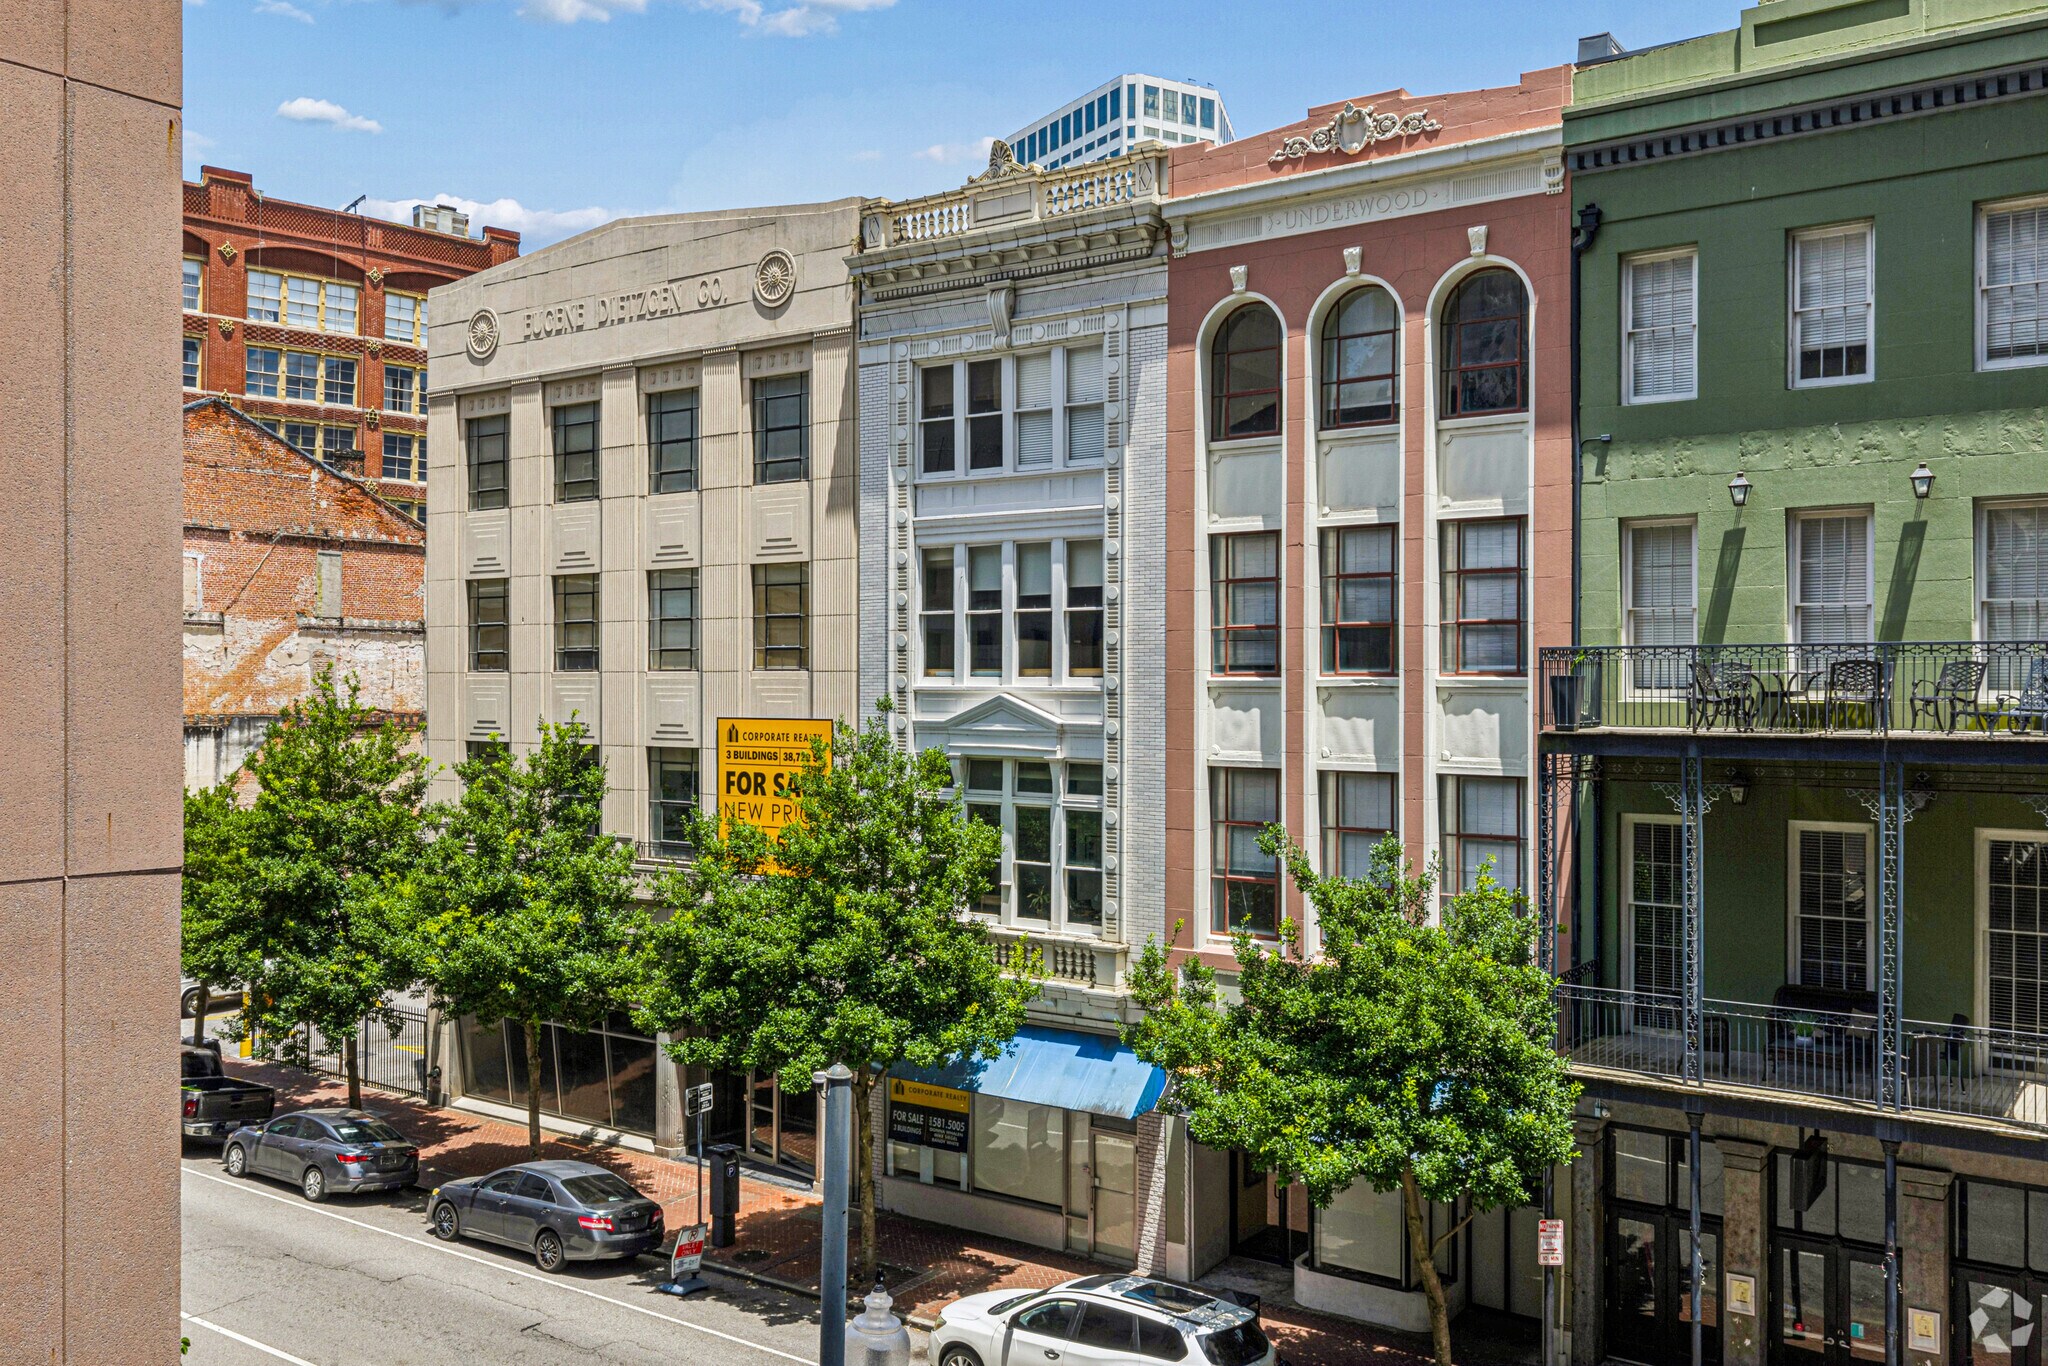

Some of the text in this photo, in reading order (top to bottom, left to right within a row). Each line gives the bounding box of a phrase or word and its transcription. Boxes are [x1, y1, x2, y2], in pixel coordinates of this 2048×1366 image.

[1284, 187, 1428, 229] UNDERWOOD
[523, 303, 585, 340] EUGENE
[598, 284, 682, 328] DIETZGEN
[742, 731, 823, 743] CORPORATE REATY
[726, 750, 779, 761] 3 BUILDINGS
[783, 752, 811, 763] 38,7
[726, 771, 802, 798] FOR SA
[724, 801, 809, 825] NEW PRIC
[908, 1086, 967, 1102] CORPORATE REALTY
[892, 1109, 907, 1122] FOR
[908, 1112, 924, 1125] SALE
[932, 1116, 965, 1132] 581.5005
[897, 1125, 922, 1136] BUILDINGS
[681, 1248, 697, 1257] ONLY
